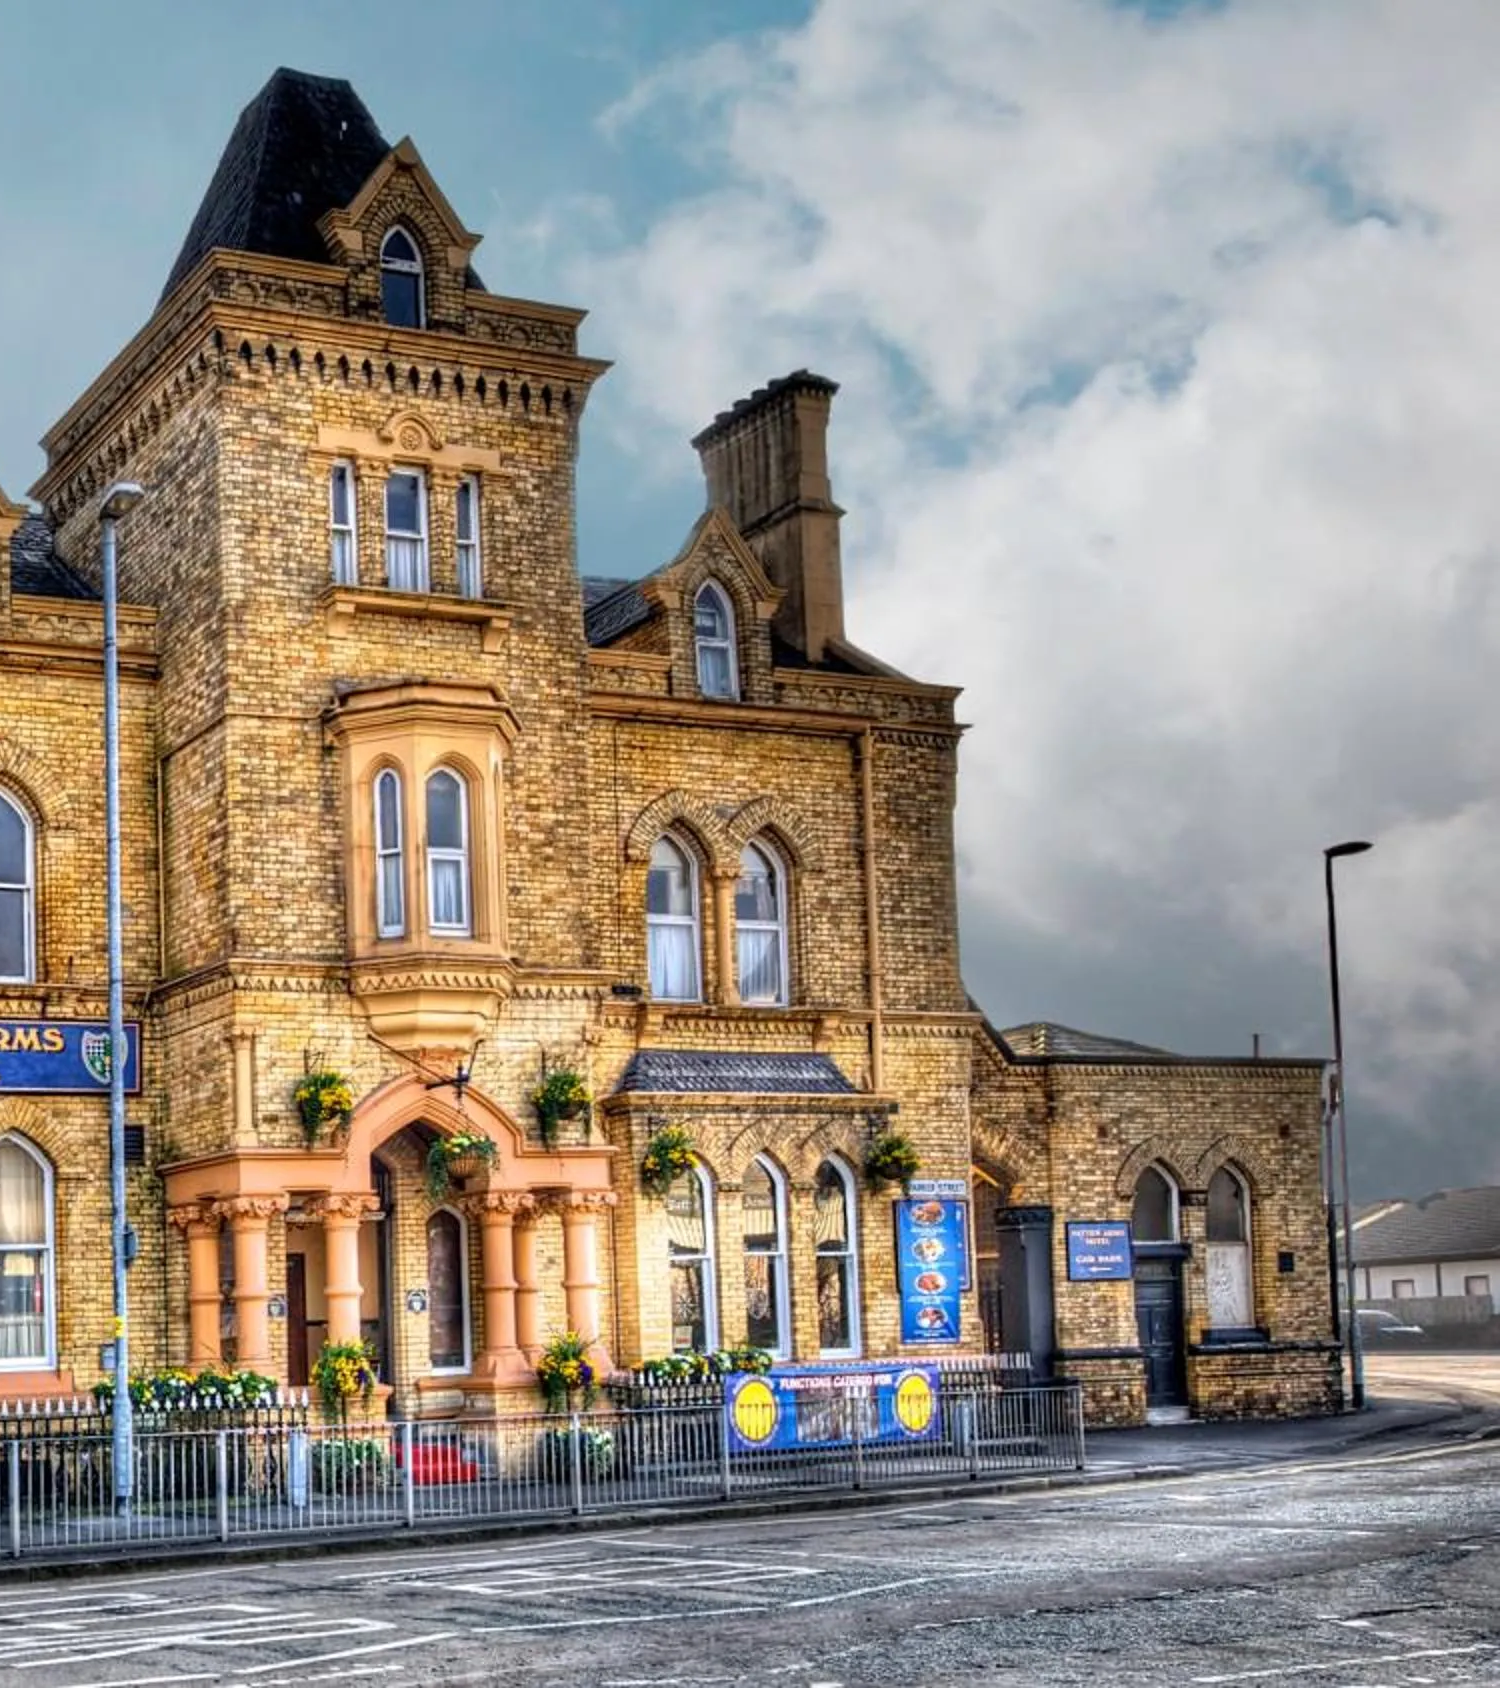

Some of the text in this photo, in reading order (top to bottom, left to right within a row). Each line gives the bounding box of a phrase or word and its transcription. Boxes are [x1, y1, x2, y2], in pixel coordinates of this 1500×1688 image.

[1075, 1255, 1123, 1264] CAR PARK
[780, 1376, 832, 1389] FUNCTIONS
